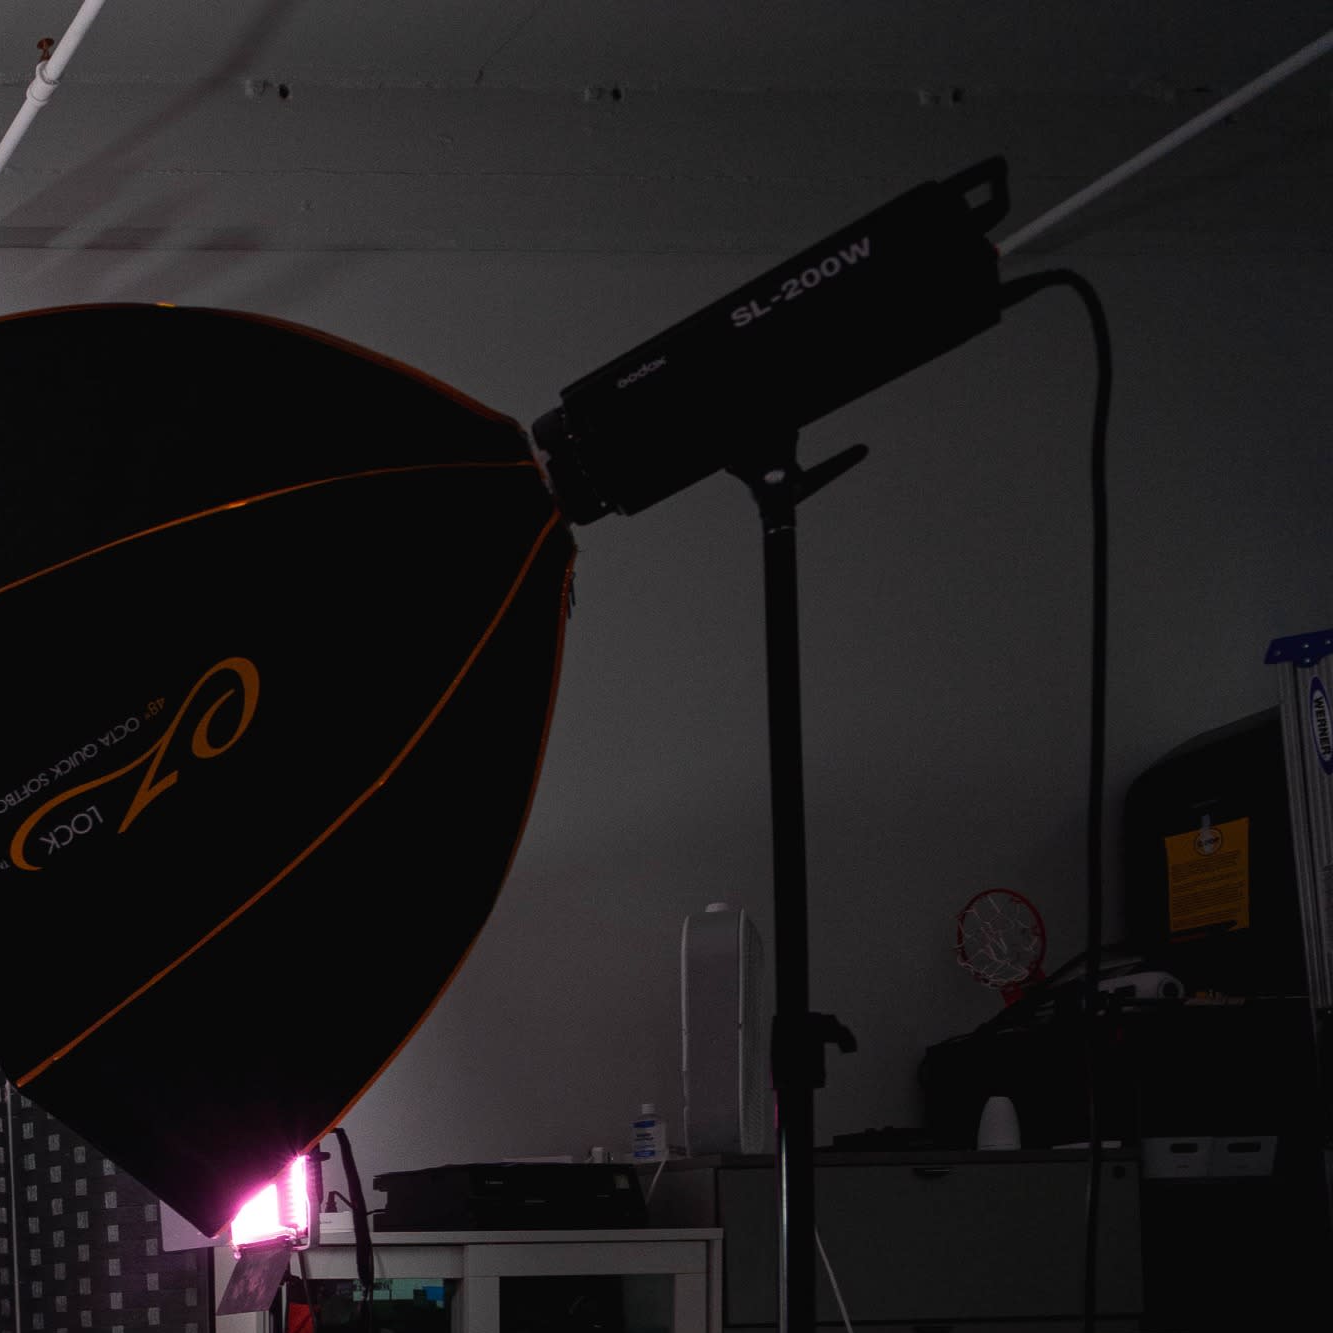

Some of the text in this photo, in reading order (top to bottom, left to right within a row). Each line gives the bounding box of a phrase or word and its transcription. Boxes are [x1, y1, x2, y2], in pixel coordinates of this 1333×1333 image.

[729, 236, 873, 329] SL-200W
[97, 715, 141, 748] OCTA
[1313, 696, 1332, 757] WERNER
[51, 742, 100, 781] QUICK
[38, 804, 106, 856] LOCK
